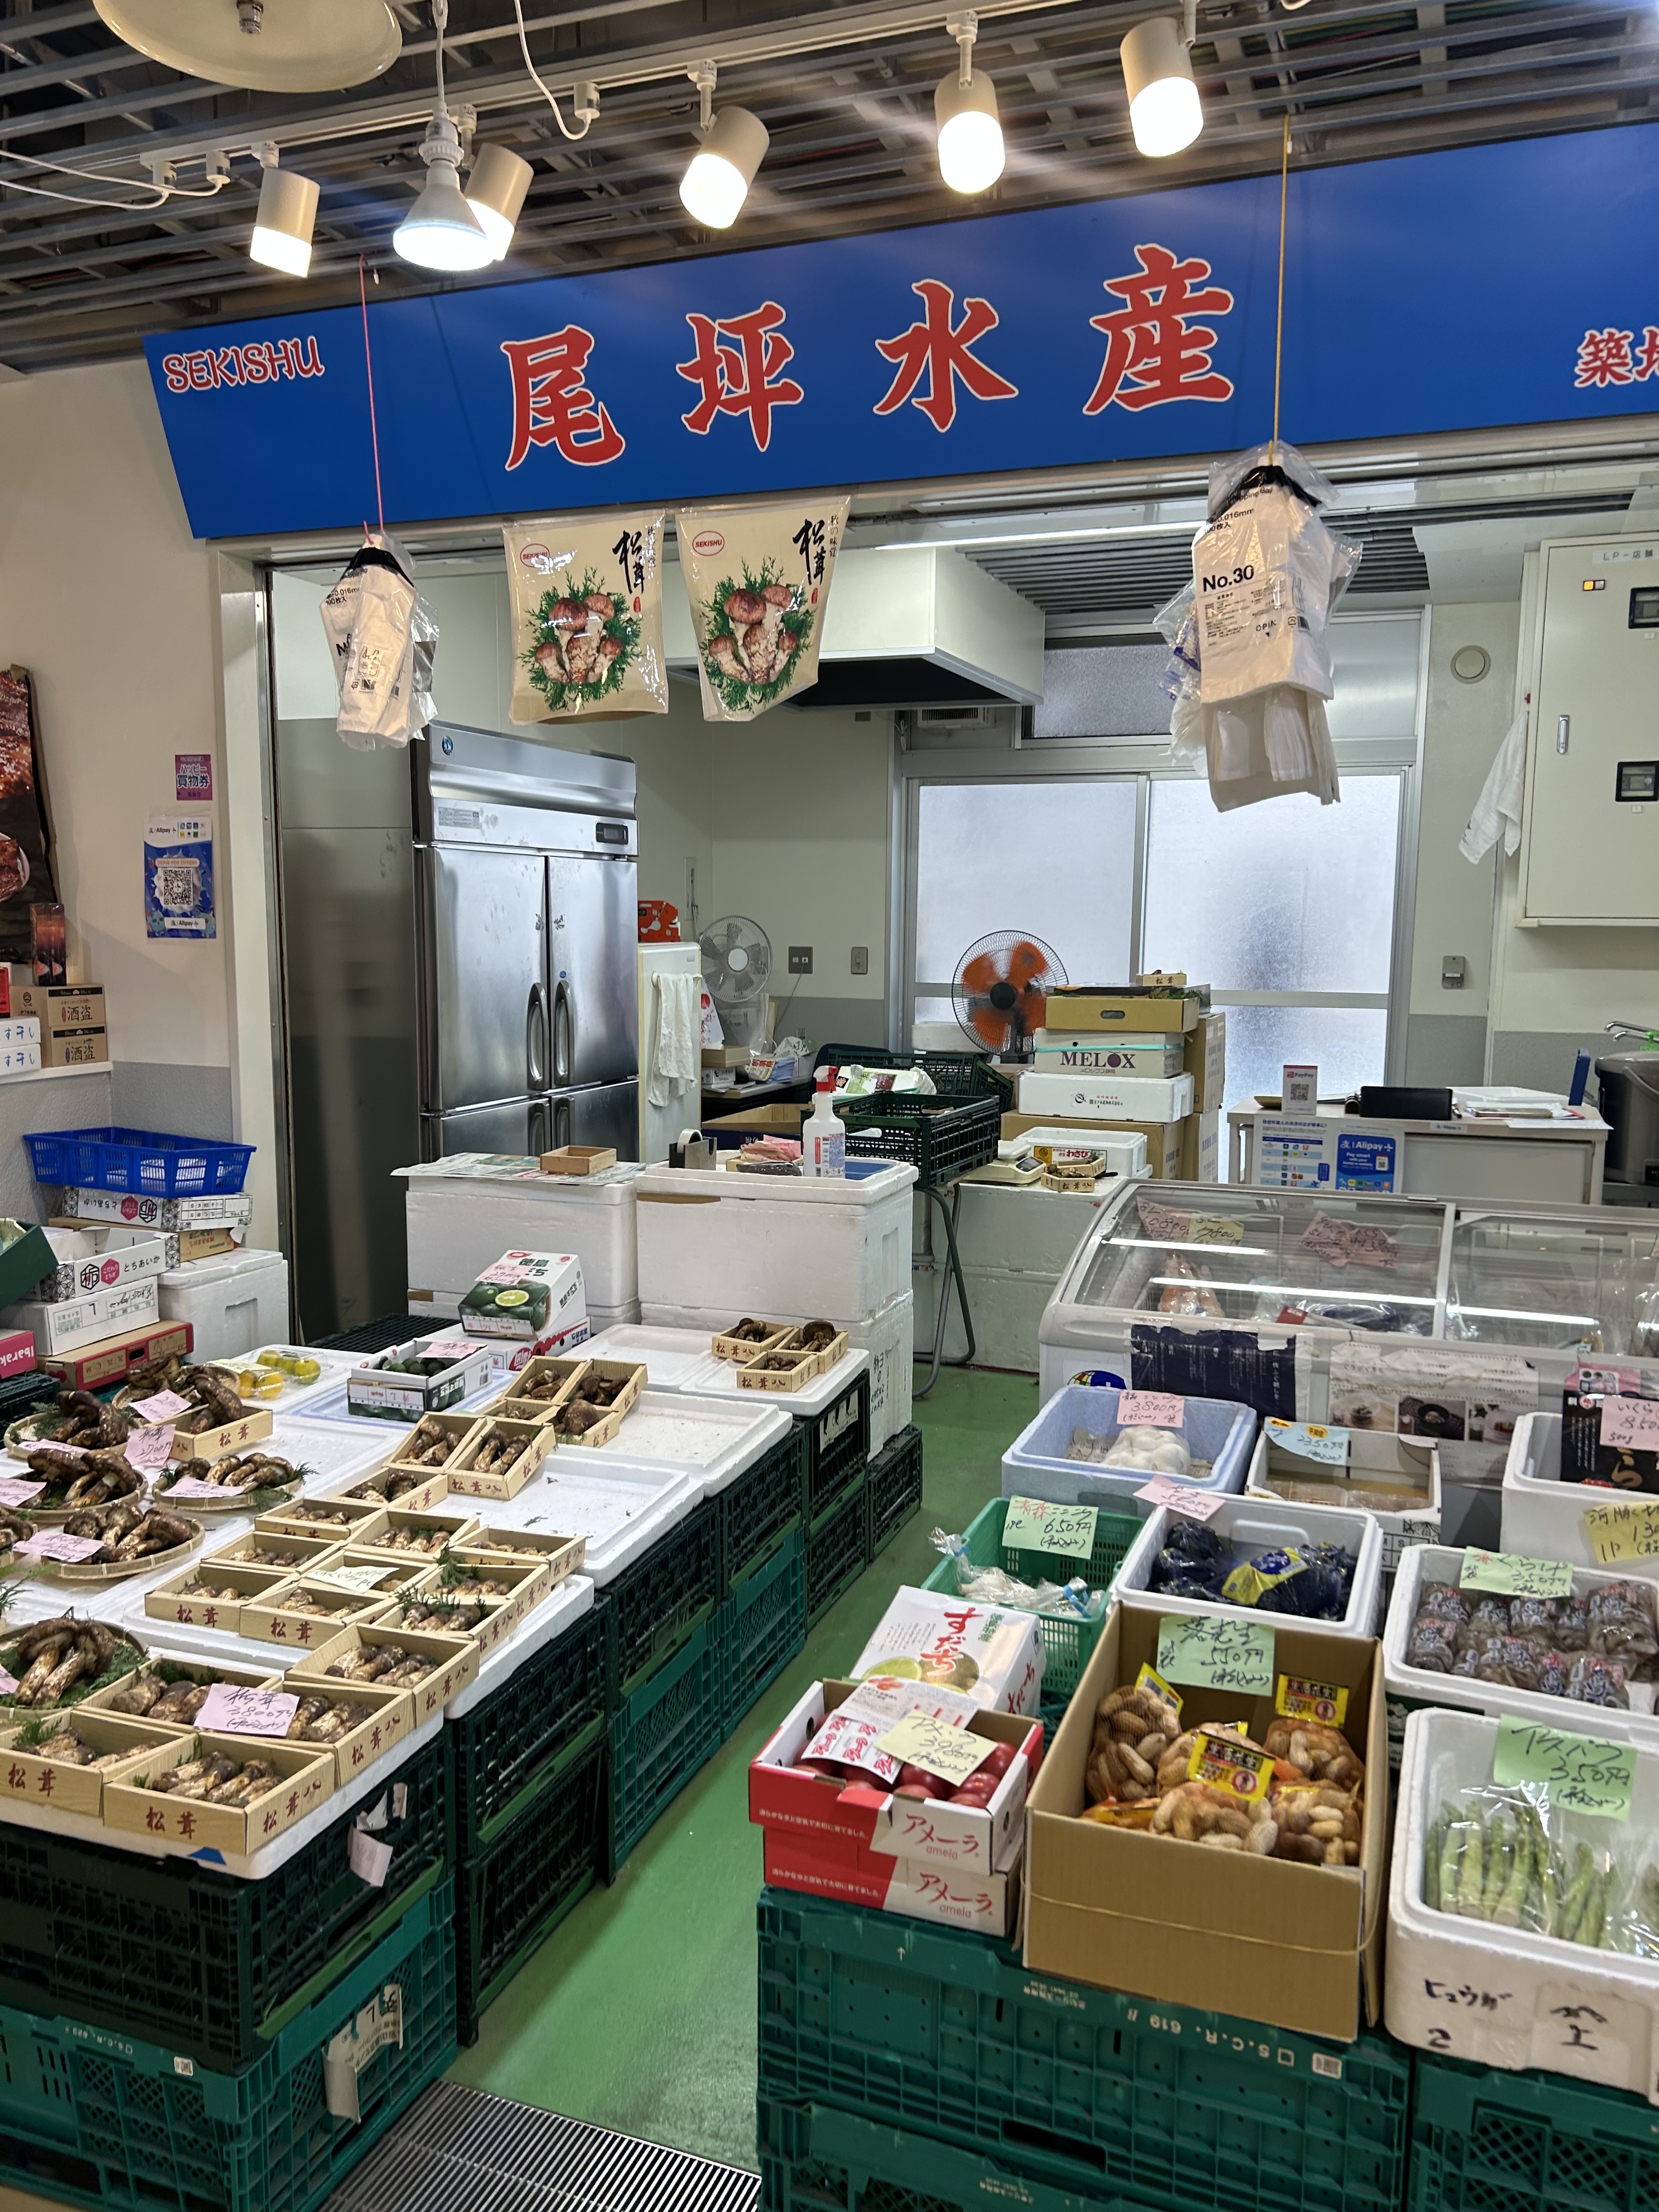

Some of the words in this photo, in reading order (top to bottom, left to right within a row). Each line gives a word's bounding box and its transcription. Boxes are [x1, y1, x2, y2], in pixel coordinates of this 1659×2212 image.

[162, 335, 325, 393] SEKISHU
[500, 240, 1235, 472] 尾坪水産
[695, 539, 724, 549] SEKISHU
[1203, 565, 1255, 592] No.30
[177, 774, 210, 787] 買物券
[67, 1006, 93, 1022] 酒盗
[71, 1045, 95, 1061] 酒盗
[1060, 1050, 1136, 1069] MELOX
[1066, 1149, 1089, 1158] わさび
[1355, 1141, 1384, 1152] Alipay
[124, 1255, 160, 1273] とちあいか
[716, 1342, 740, 1357] 松茸
[742, 1376, 769, 1390] 松茸
[624, 1381, 639, 1410] 松茸
[219, 1424, 250, 1448] 松茸
[593, 1424, 610, 1447] 松茸
[523, 1446, 543, 1478] 松茸
[452, 1478, 482, 1494] 松茸
[554, 1553, 571, 1577] 松茸
[516, 1585, 536, 1617] 松茸
[177, 1604, 219, 1628] 松茸
[270, 1616, 313, 1645] 松茸
[479, 1621, 500, 1653] 松茸
[919, 1607, 984, 1677] すだち
[224, 1686, 281, 1710] 松茸
[426, 1673, 453, 1712] 松茸
[352, 1725, 382, 1767] 松茸
[8, 1762, 57, 1797] 松茸
[146, 1805, 197, 1840] 松茸
[263, 1791, 300, 1835] 松茸
[902, 1812, 980, 1855] アメーラ
[926, 1844, 958, 1860] amela
[915, 1871, 993, 1914] アメーラ
[939, 1904, 972, 1918] amela
[1149, 2013, 1182, 2035] 619
[1196, 2025, 1270, 2058] S.C.R.
[1428, 2028, 1452, 2049] 2
